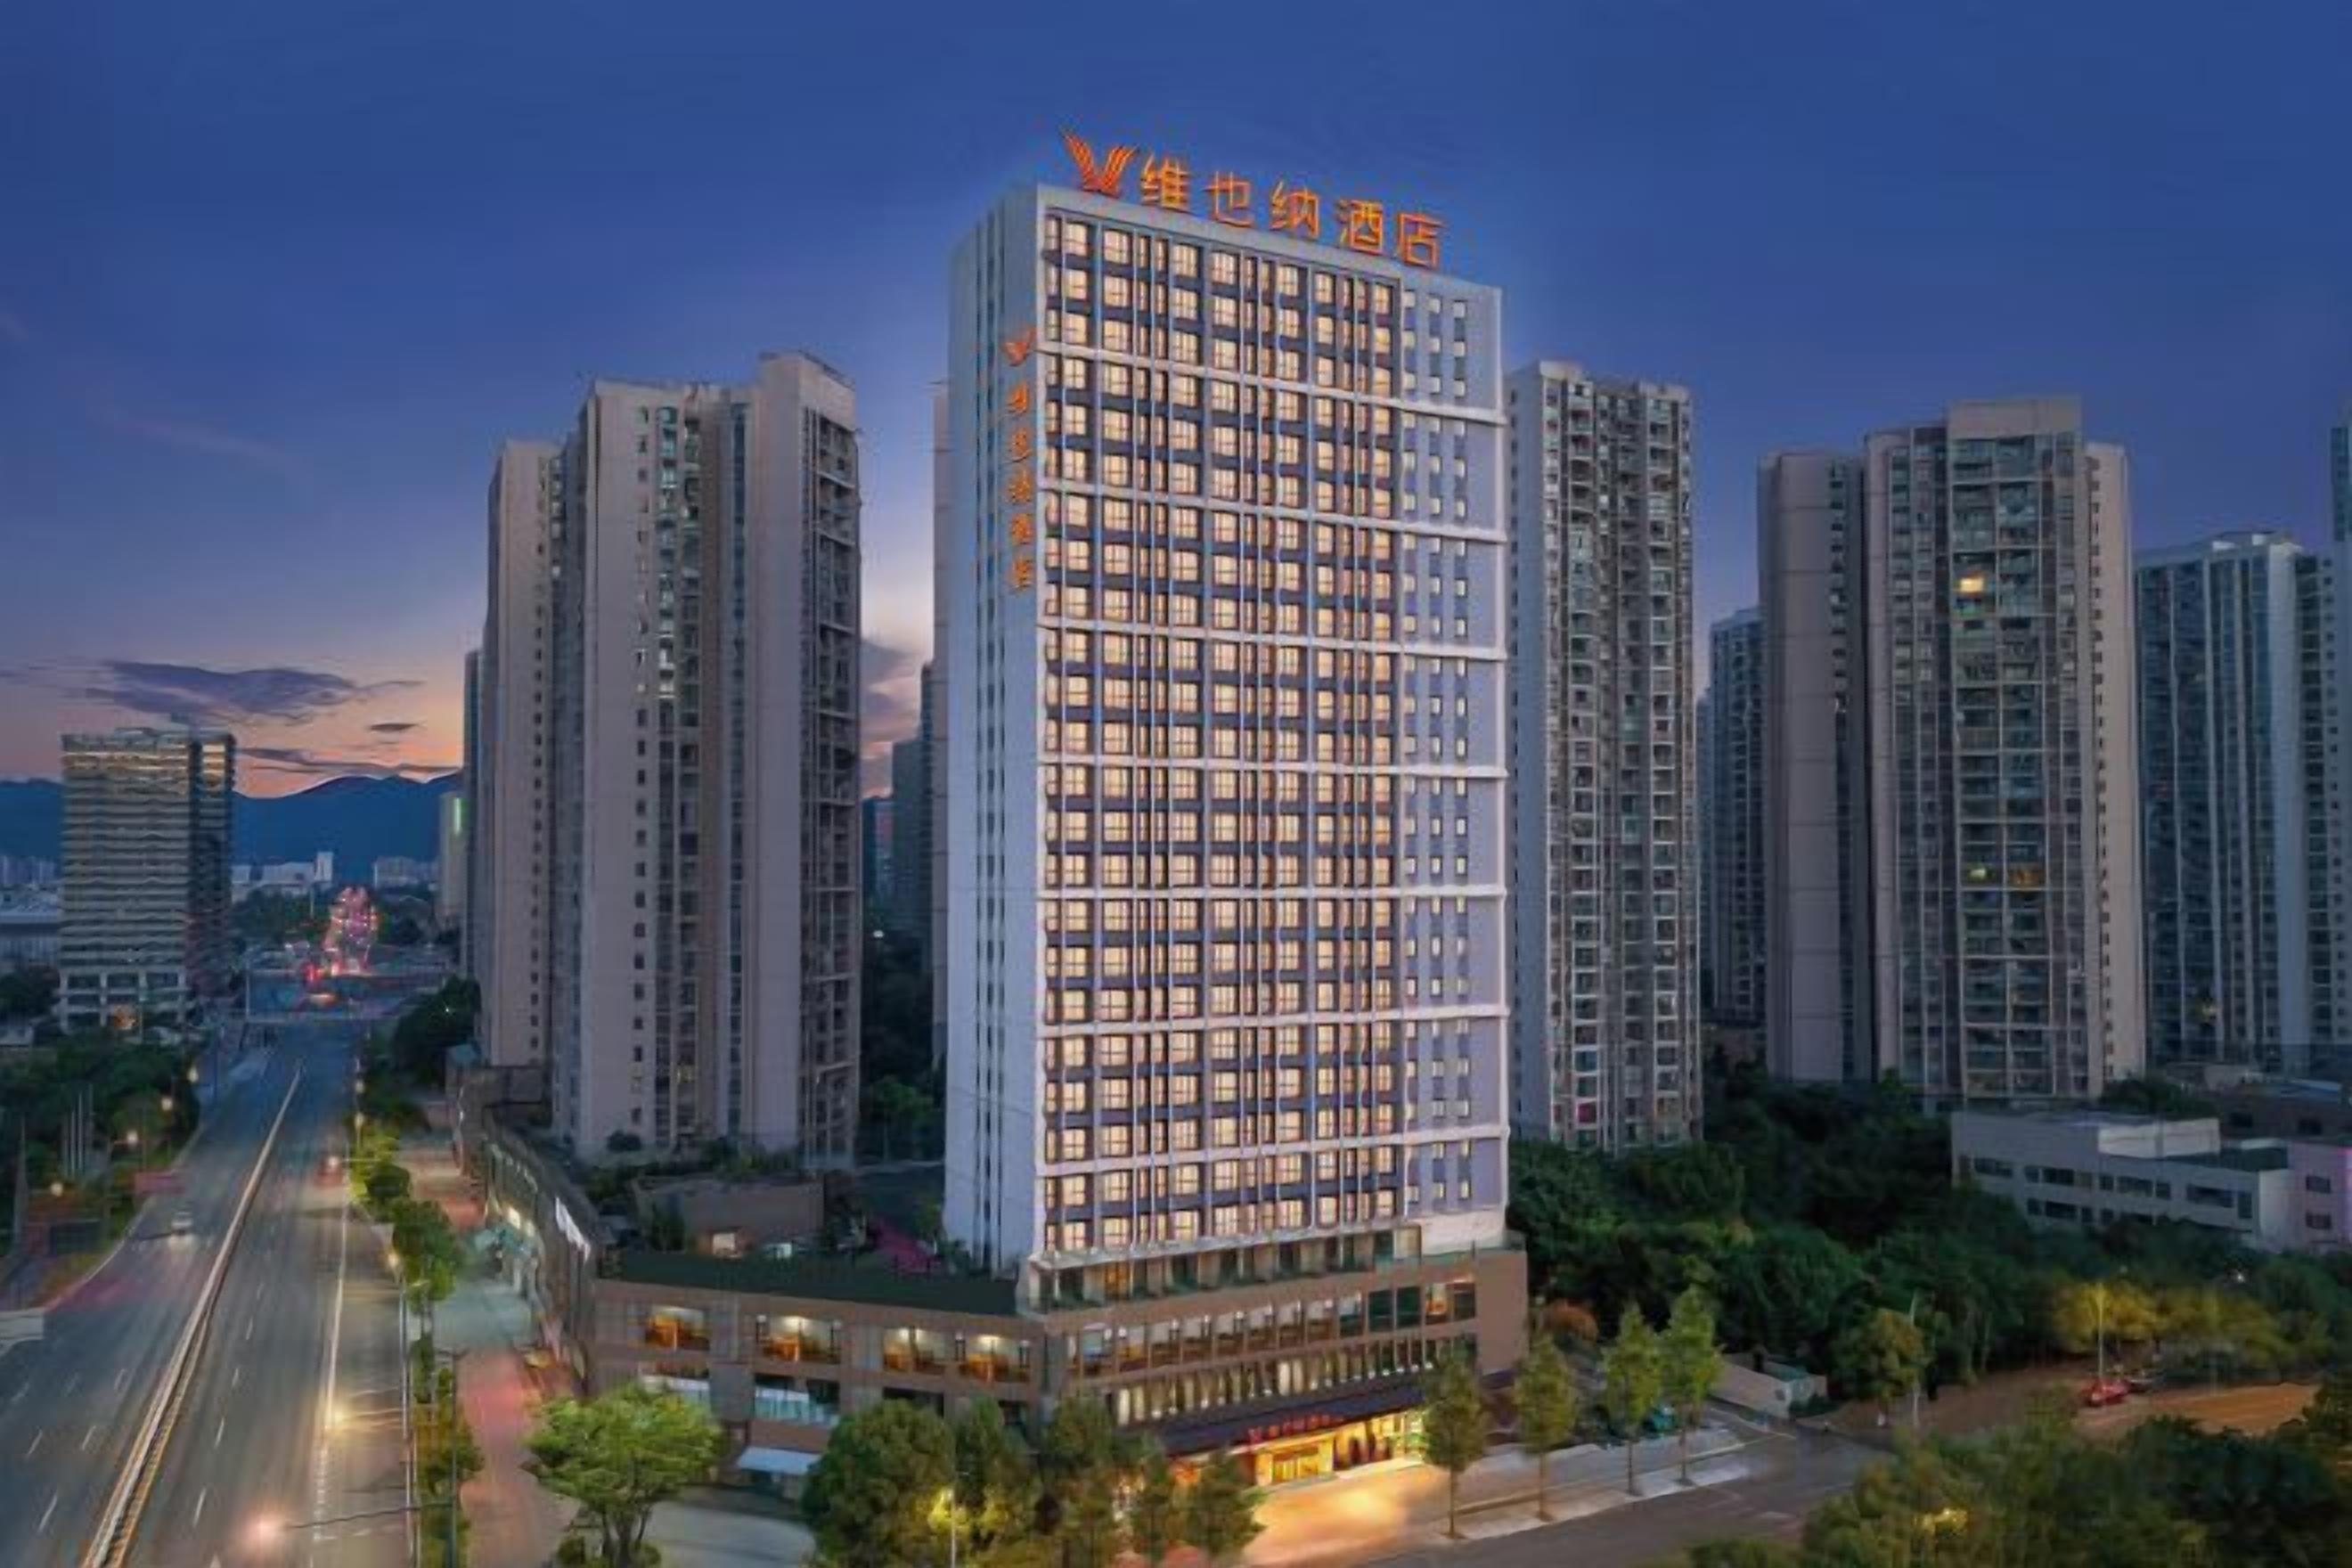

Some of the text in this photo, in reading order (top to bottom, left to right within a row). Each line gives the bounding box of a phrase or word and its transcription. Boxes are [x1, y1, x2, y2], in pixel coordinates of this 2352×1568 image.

[1139, 152, 1444, 267] 维也纳酒店
